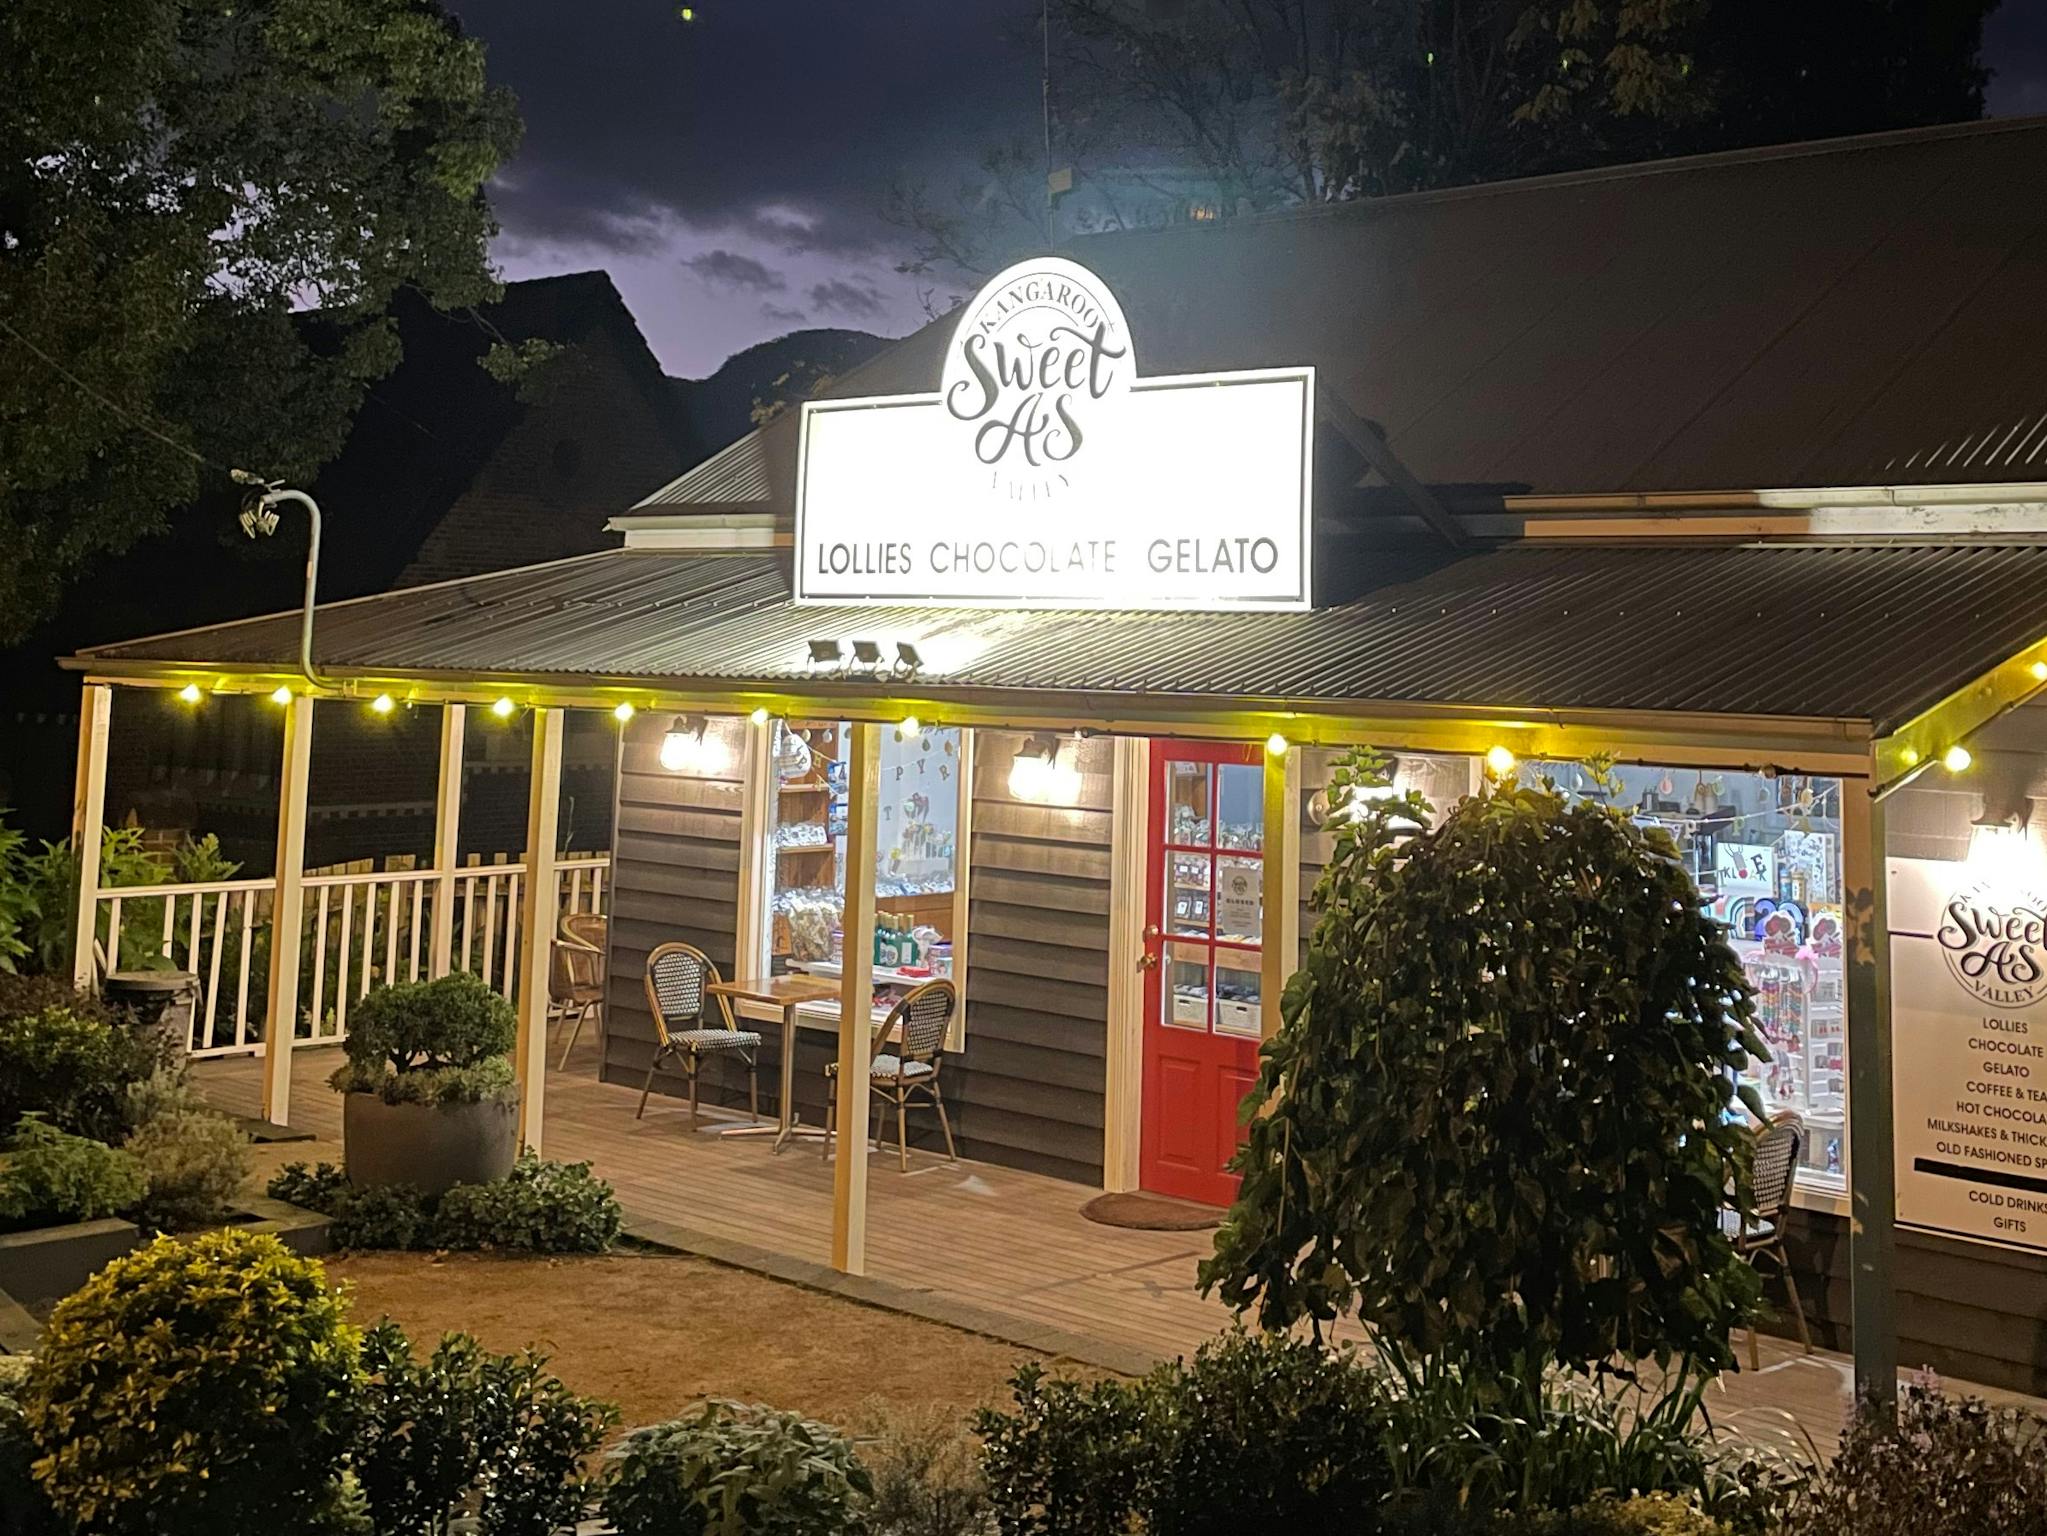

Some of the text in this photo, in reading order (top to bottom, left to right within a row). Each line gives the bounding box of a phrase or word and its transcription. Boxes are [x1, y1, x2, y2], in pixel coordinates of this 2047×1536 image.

[946, 324, 1127, 420] Sweet
[818, 537, 1279, 575] LOLLIES CHOCOLATE GELATO
[1974, 979, 2035, 1003] VALLEY
[1983, 1017, 2029, 1034] LOLLIES
[1968, 1037, 2045, 1058] CHOCOLATE
[1983, 1061, 2030, 1078] GELATO
[1966, 1080, 2047, 1102] COFFEE & TEA
[1956, 1101, 1981, 1115] HOT
[1927, 1117, 1997, 1139] MILKSHAKES
[2000, 1129, 2009, 1140] &
[1936, 1141, 1961, 1155] OLD
[1964, 1145, 2032, 1167] FASHIONED
[1969, 1190, 2004, 1206] COLD
[1993, 1216, 2027, 1233] GIFTS
